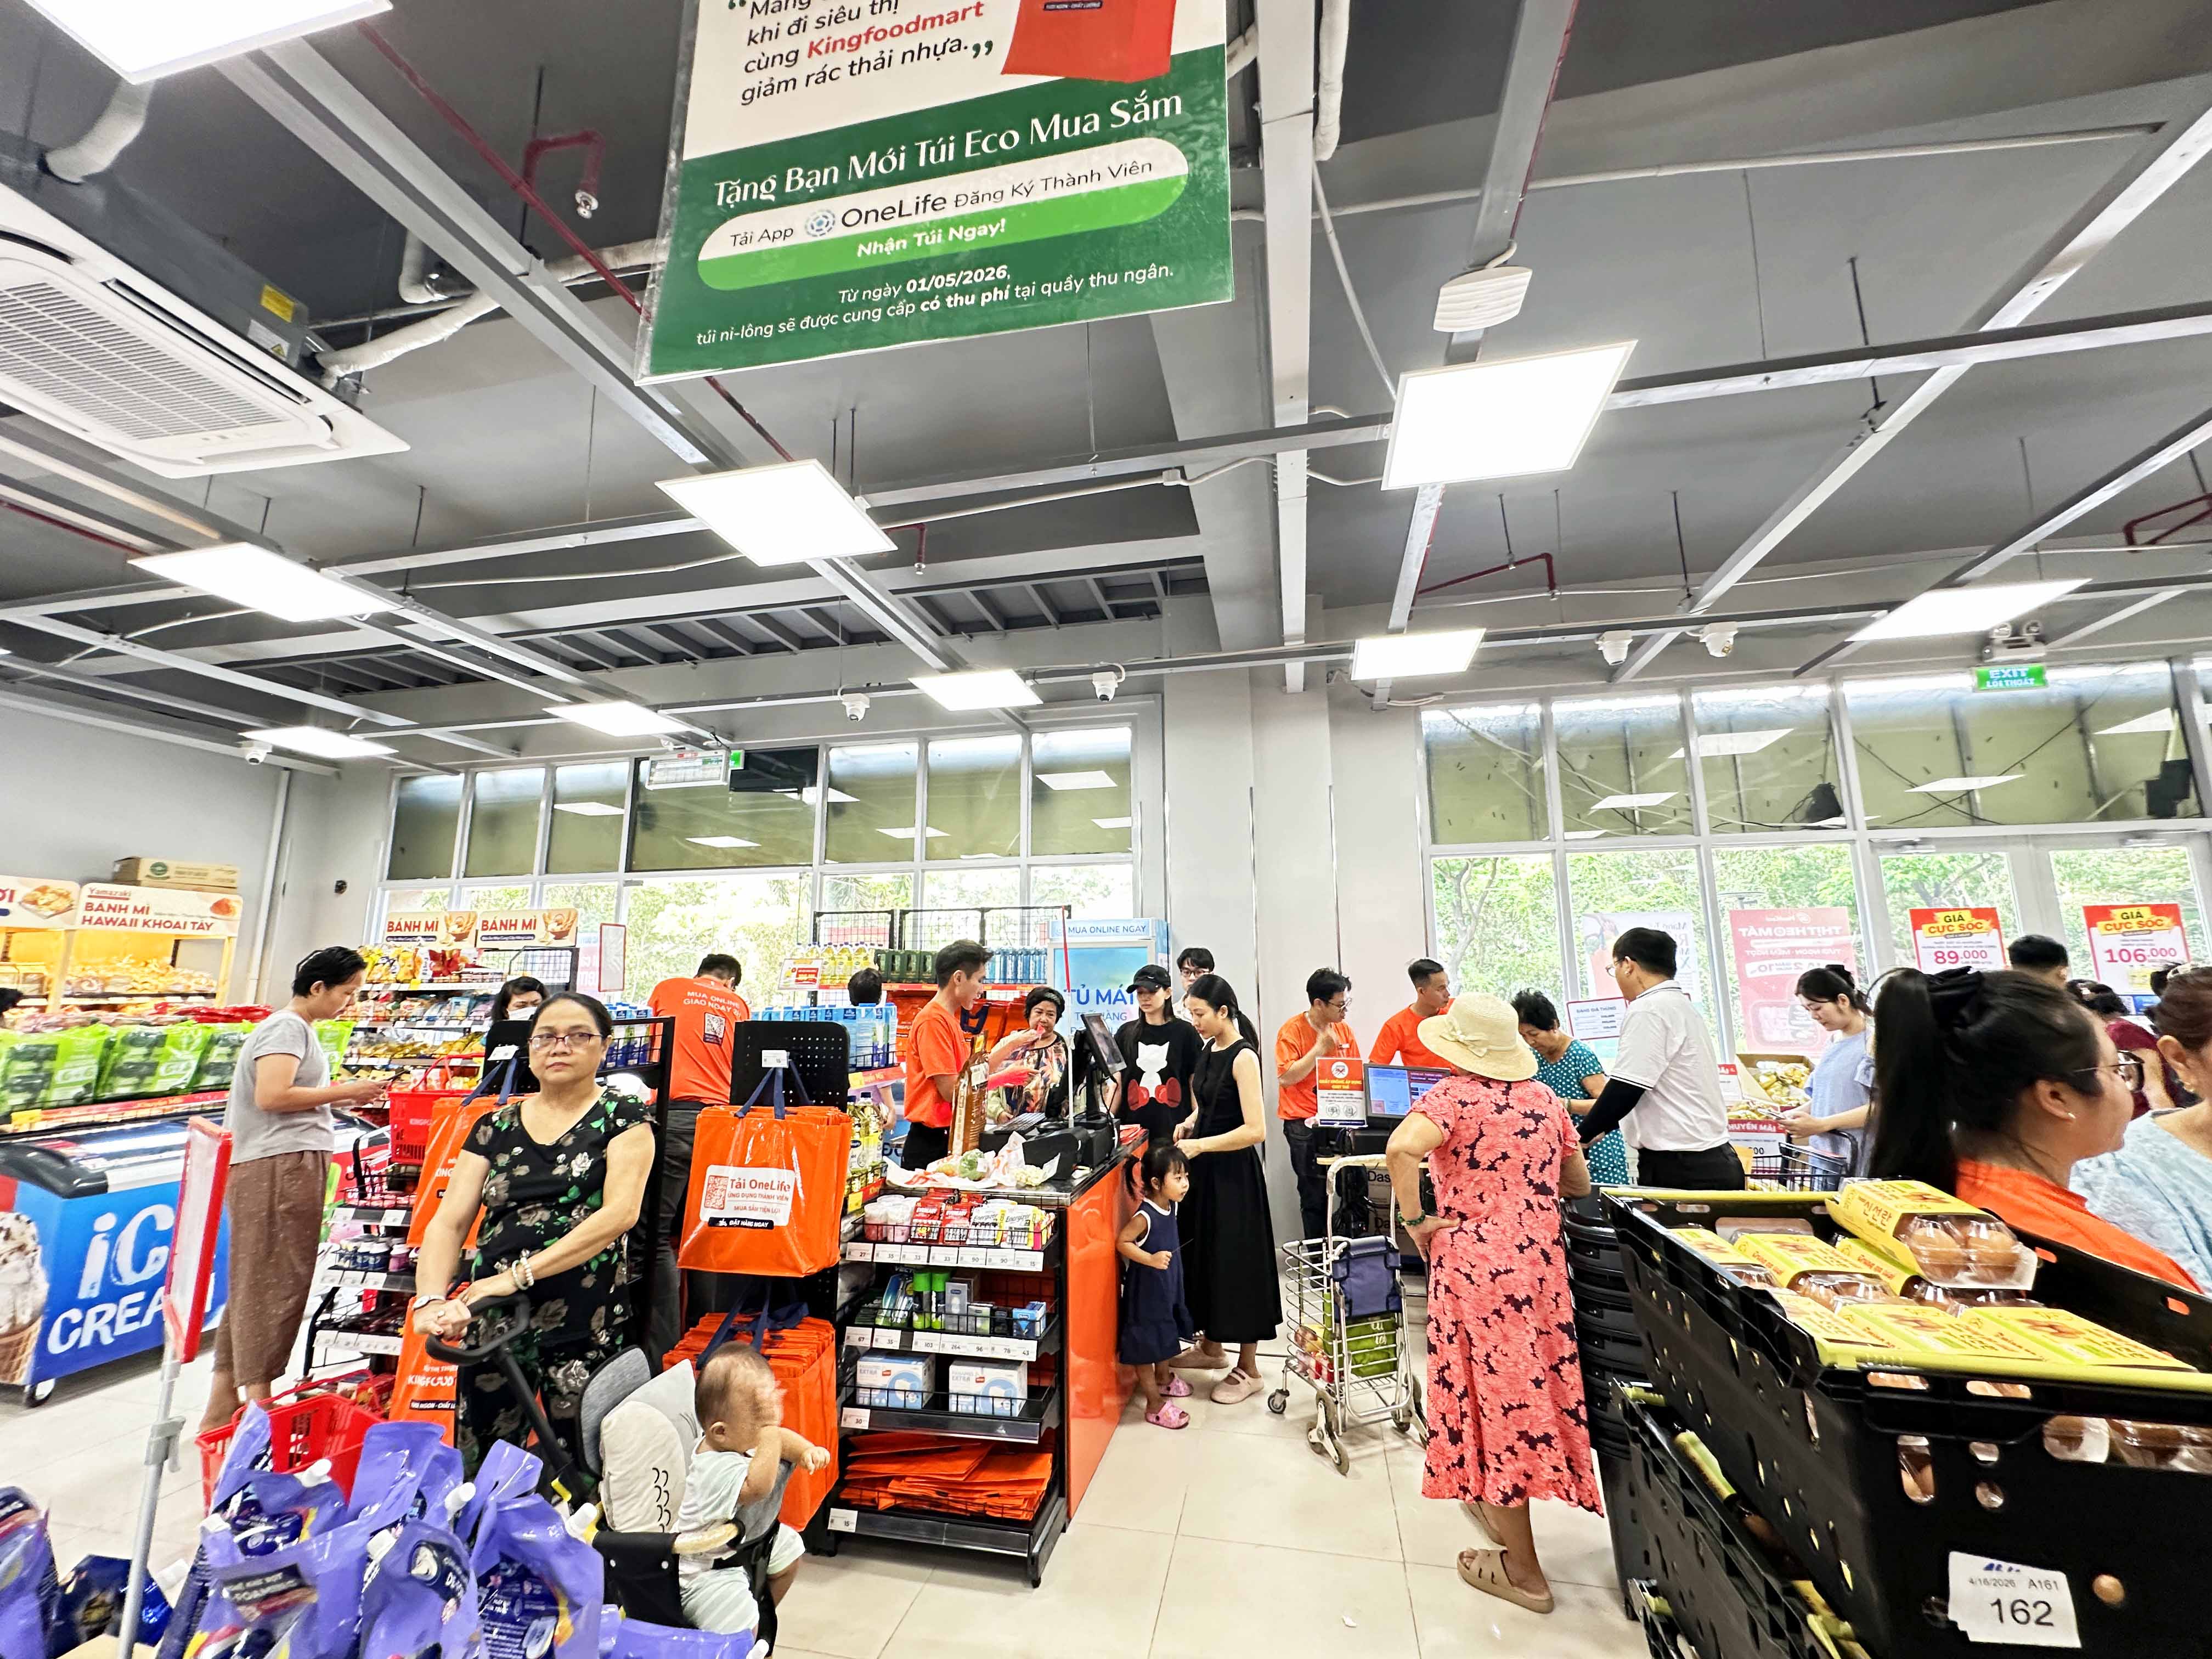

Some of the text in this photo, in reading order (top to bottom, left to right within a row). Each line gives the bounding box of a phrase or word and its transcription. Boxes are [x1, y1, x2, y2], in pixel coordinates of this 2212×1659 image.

[750, 0, 811, 19] Mang
[747, 0, 900, 47] khi đi siêu thị
[744, 1, 986, 74] cùng Kingfoodmart
[741, 37, 968, 106] giảm rác thải nhựa.
[714, 89, 1182, 208] Tặng Bạn Mới Túi Eco Mua Sắm
[729, 160, 1153, 247] Tải App OneLife Đăng Ký Thành Viên
[856, 217, 1007, 258] Nhận Túi Ngay!
[838, 264, 1011, 304] Từ ngày 01/05/2026,
[696, 262, 1175, 346] túi ni-lông sẽ được cung cấp có thu phí tại quầy thu ngân.
[1989, 667, 2029, 679] EXIT
[2004, 678, 2035, 687] THOÁT
[88, 887, 132, 898] Yamazaki
[84, 901, 129, 915] BÁNH
[2120, 908, 2144, 920] GIÁ
[81, 915, 138, 928] HAWAII
[142, 919, 187, 930] KHOAI
[387, 917, 422, 932] BÁNH
[481, 916, 518, 932] BÁNH
[1943, 912, 1965, 923] GIÁ
[1068, 924, 1147, 934] MUA ONLINE NGAY
[682, 998, 707, 1006] GIAO
[708, 1001, 732, 1013] NGAY
[686, 991, 741, 1009] MUA ONLINE
[1728, 1121, 1758, 1131] HUYẾN
[730, 1177, 791, 1192] Tải OneLife
[77, 1204, 175, 1300] iC
[47, 1273, 215, 1355] CREA
[2028, 1578, 2059, 1591] A161
[1989, 1598, 2055, 1628] 162
